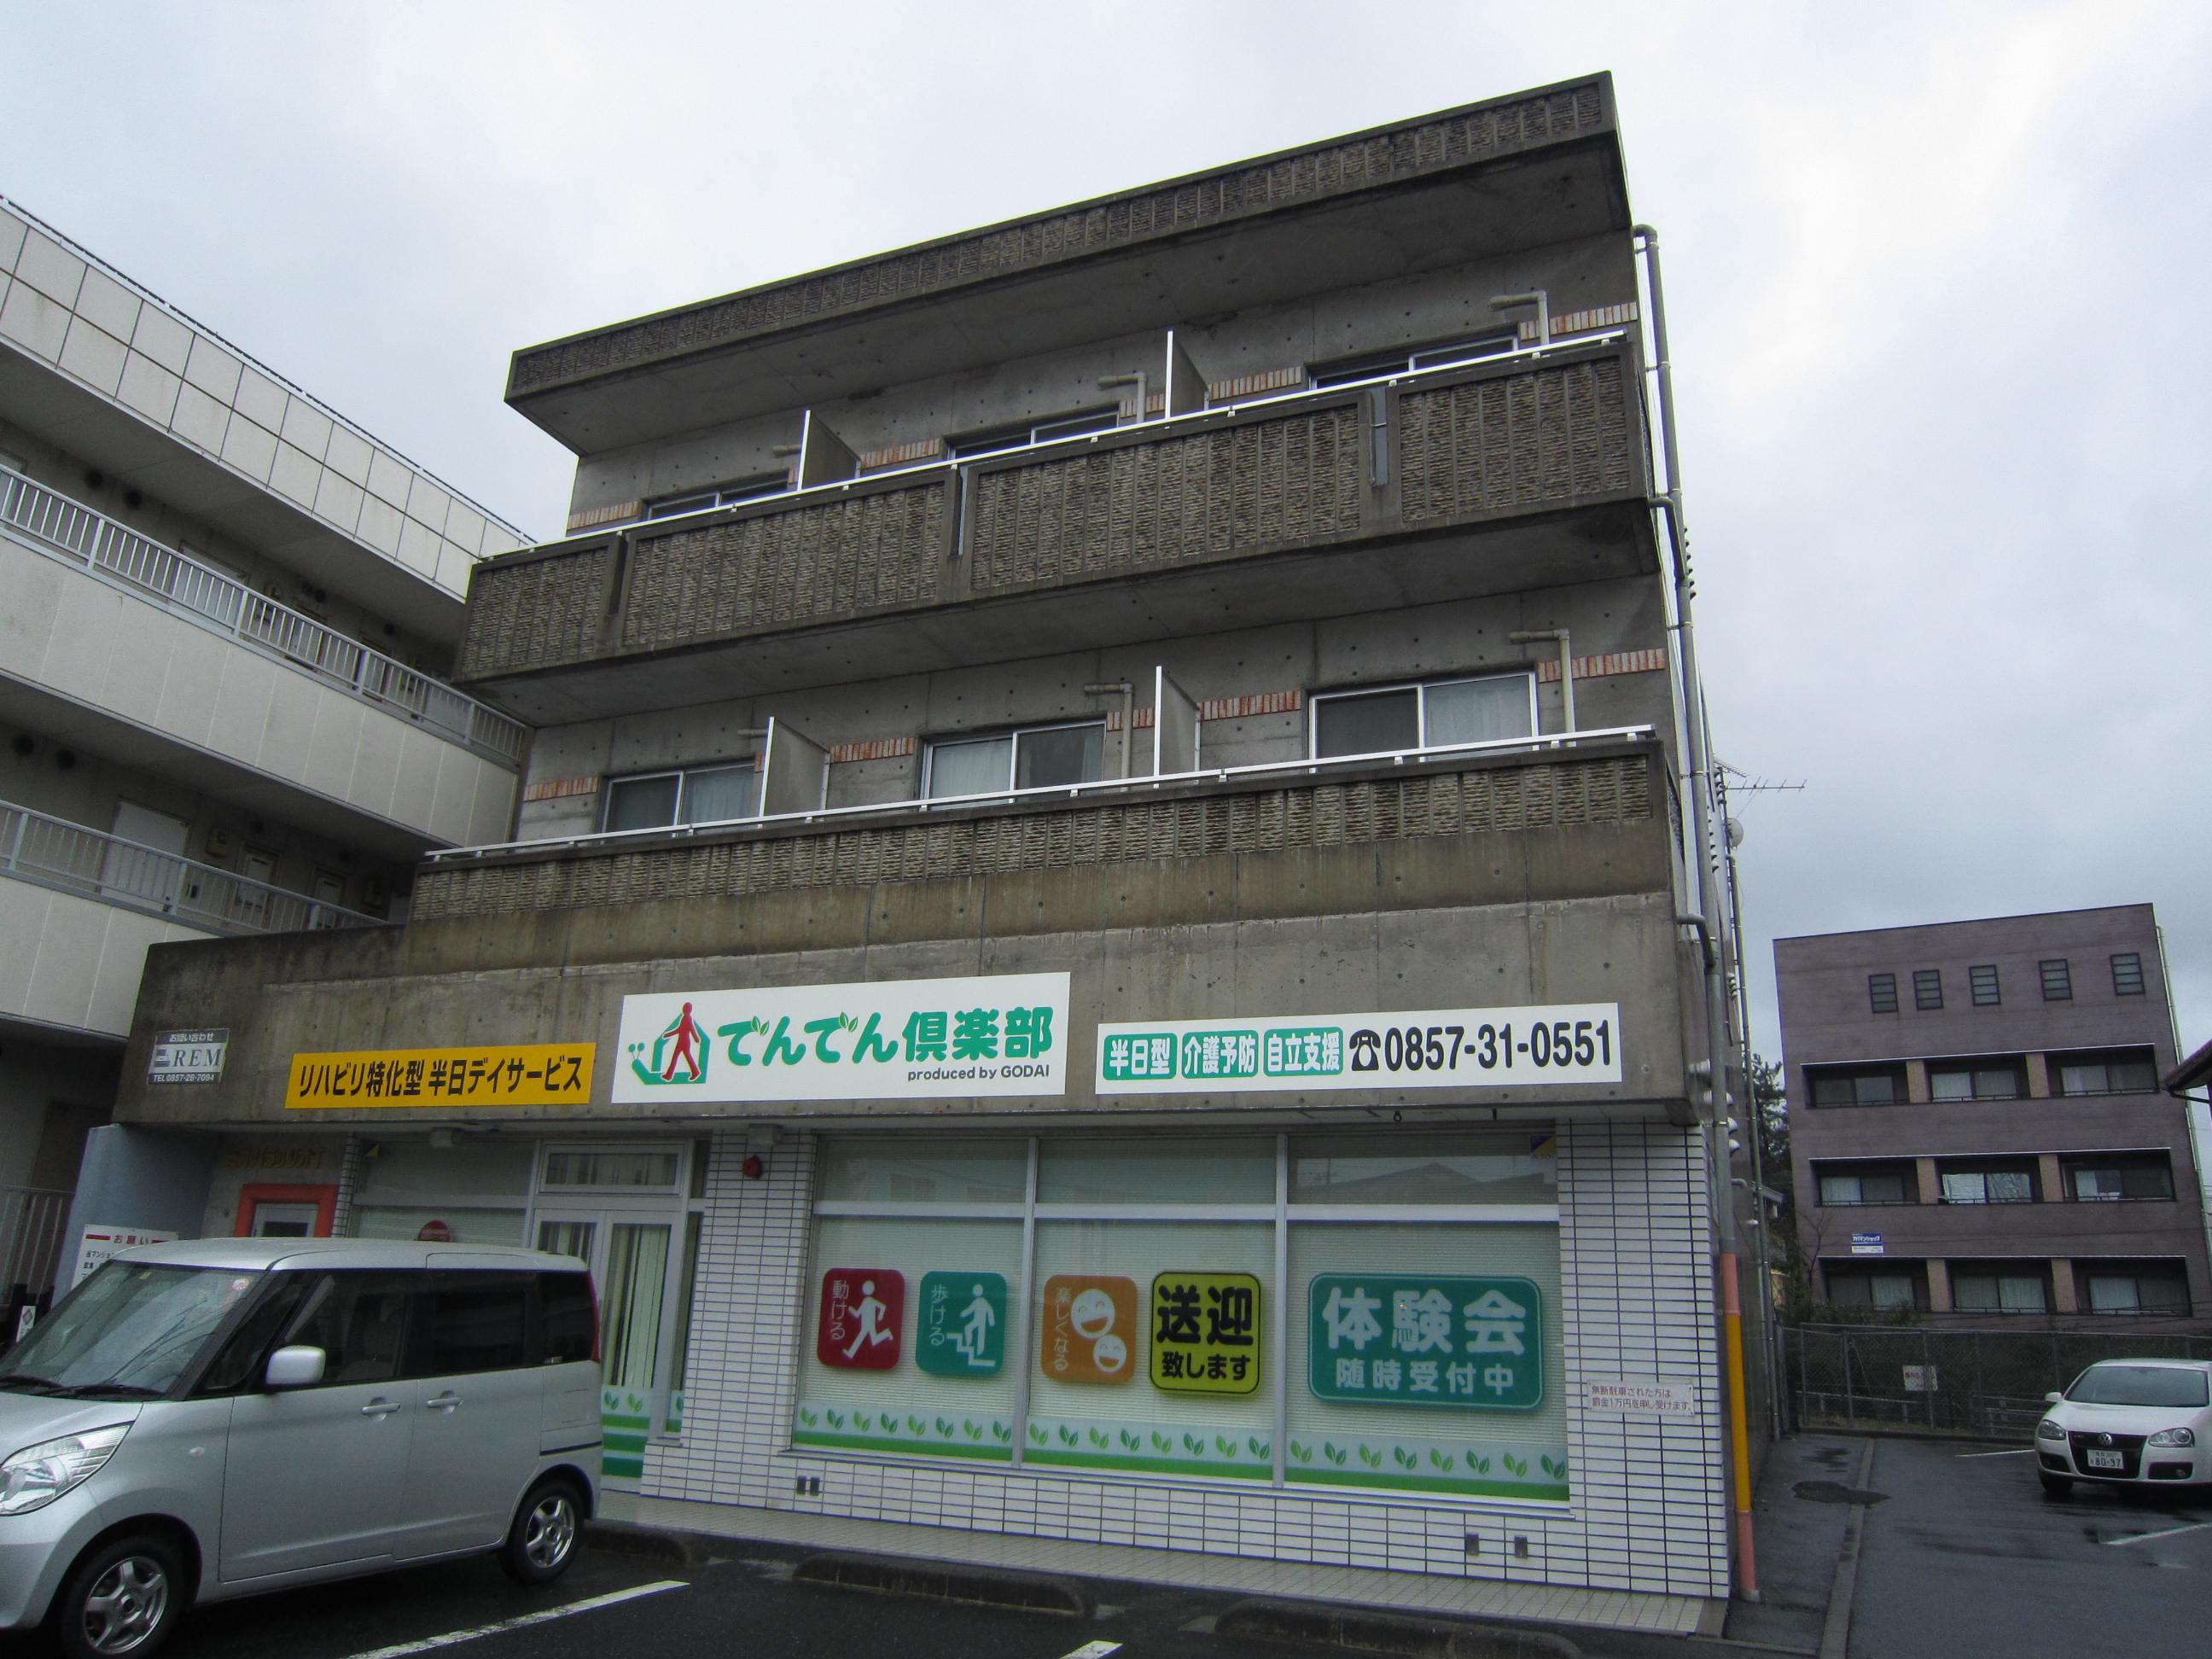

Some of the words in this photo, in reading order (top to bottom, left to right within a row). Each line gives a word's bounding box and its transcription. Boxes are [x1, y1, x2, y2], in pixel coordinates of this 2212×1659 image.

[172, 1049, 223, 1067] REM
[717, 1006, 1054, 1067] でんでん倶楽部
[1109, 1039, 1171, 1076] 半日型
[1184, 1034, 1257, 1074] 介護予防
[1266, 1033, 1342, 1073] 自立支援
[1384, 1020, 1611, 1072] 0857-31-0551
[908, 1068, 975, 1081] produced
[979, 1067, 997, 1080] by
[1000, 1065, 1050, 1078] GODAI
[830, 1279, 850, 1340] 動ける
[928, 1284, 948, 1346] 歩ける
[1053, 1287, 1072, 1371] 楽しくなる
[1156, 1284, 1254, 1346] 送迎
[1322, 1287, 1526, 1356] 体験会
[1161, 1351, 1251, 1381] 致します
[1336, 1358, 1514, 1396] 随時受付中
